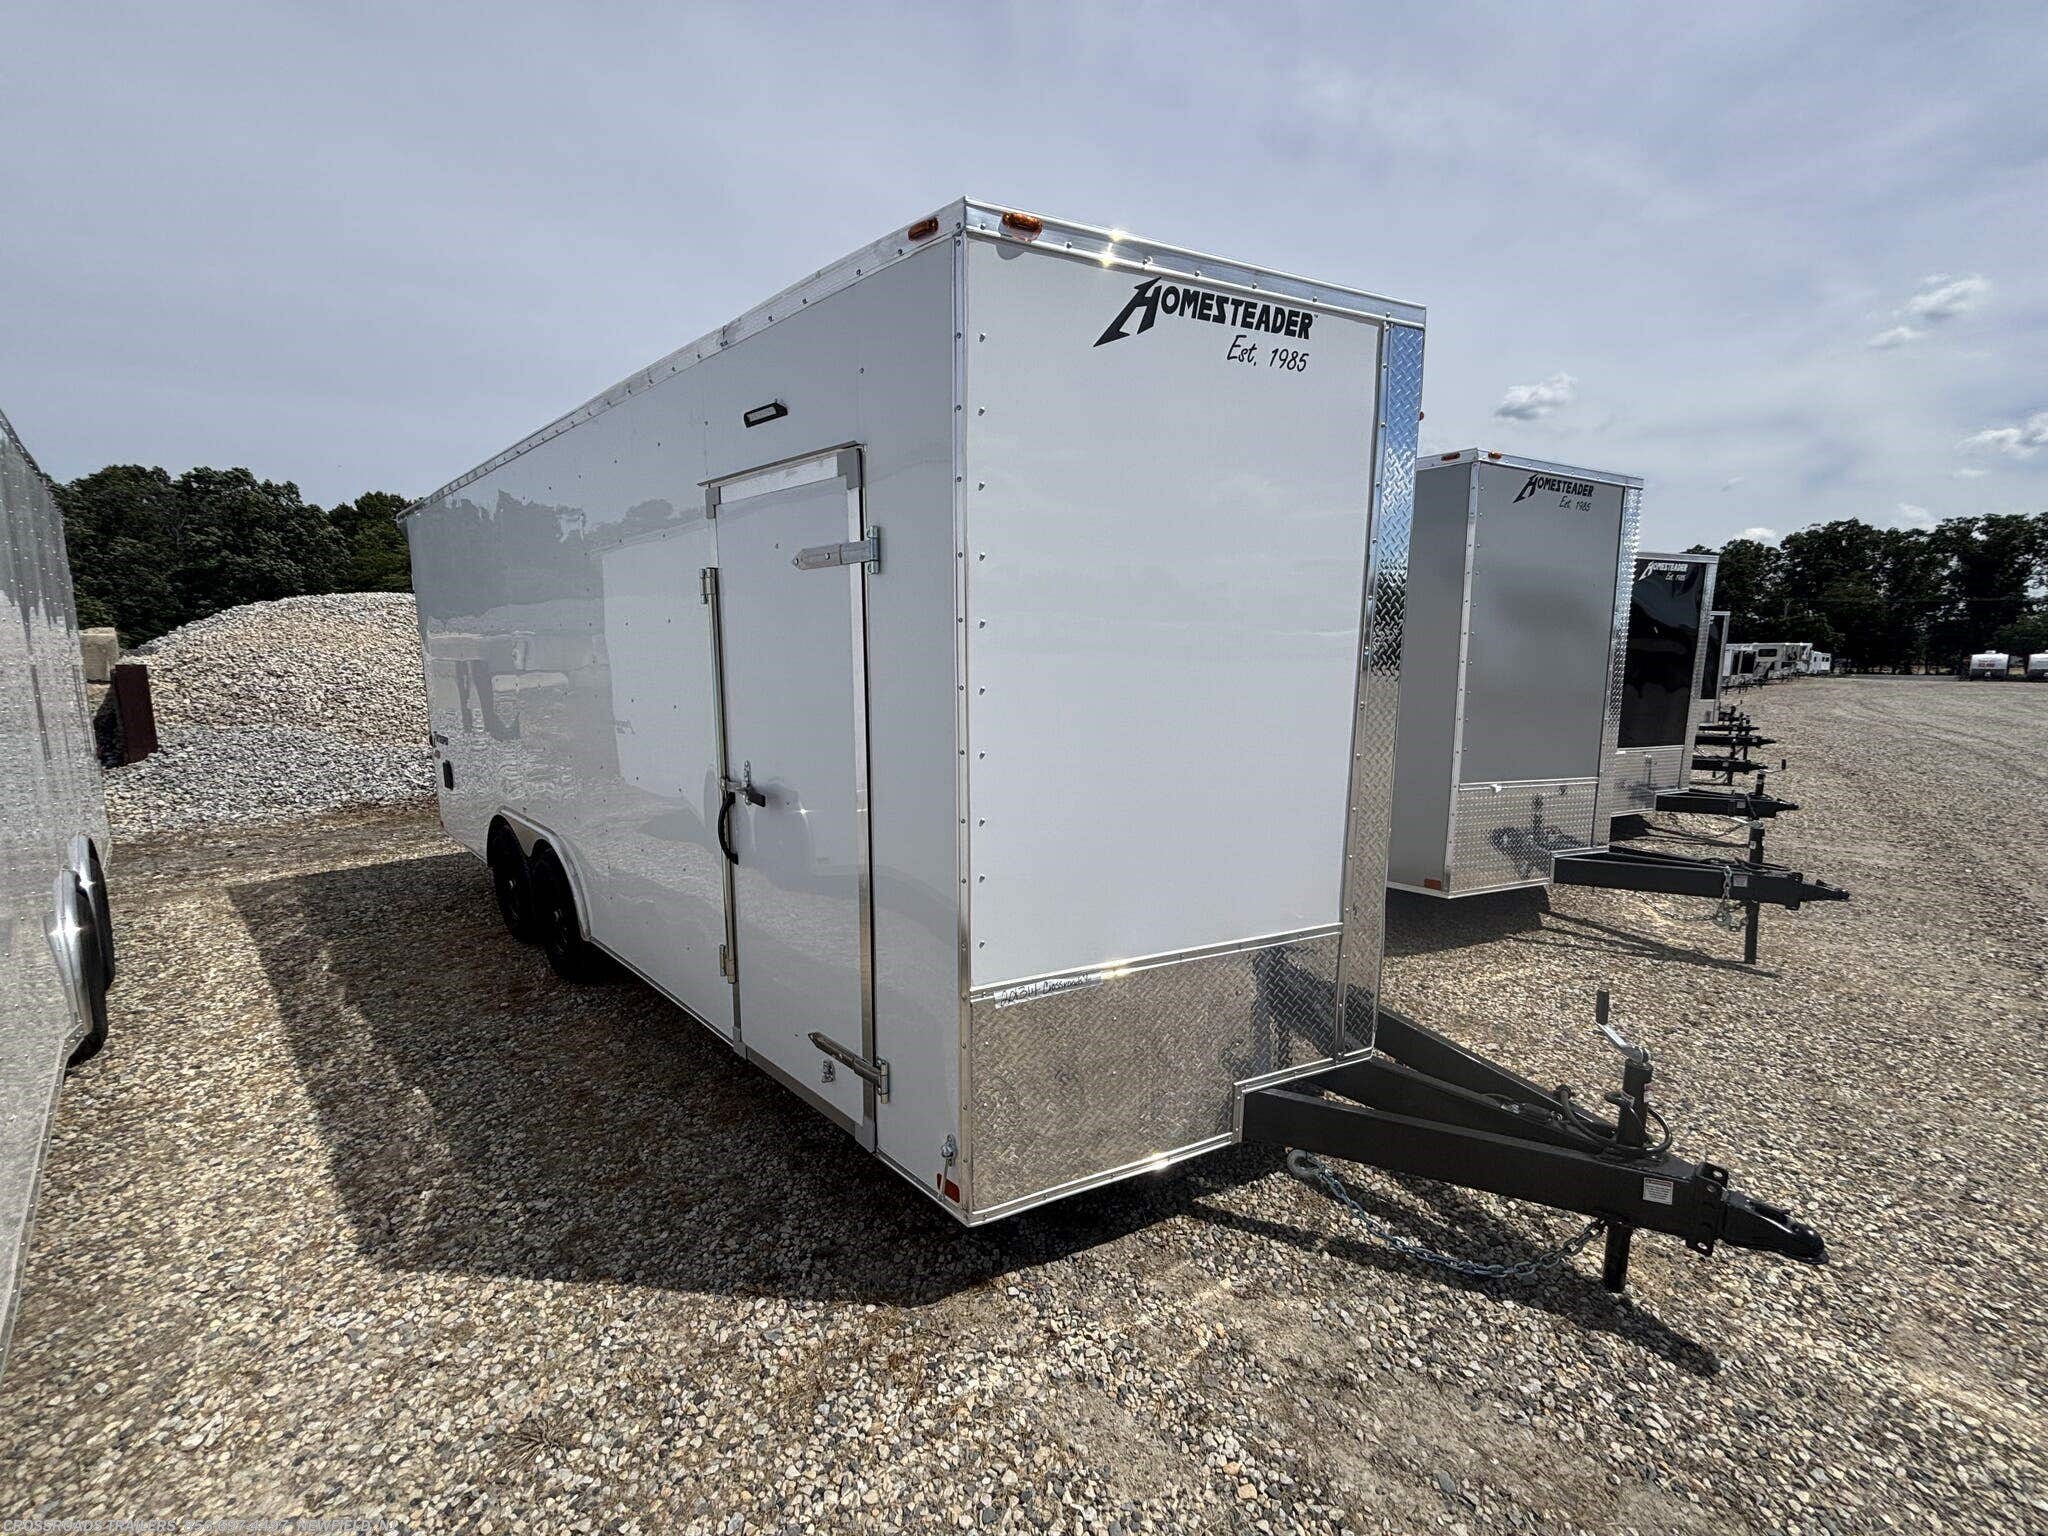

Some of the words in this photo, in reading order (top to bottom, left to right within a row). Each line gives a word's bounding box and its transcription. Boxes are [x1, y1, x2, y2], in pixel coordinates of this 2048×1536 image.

[1093, 276, 1314, 347] HOMESTEADER
[1226, 334, 1257, 366] Est.
[1269, 348, 1310, 373] 1985
[1512, 473, 1594, 503] HOMESTEADER
